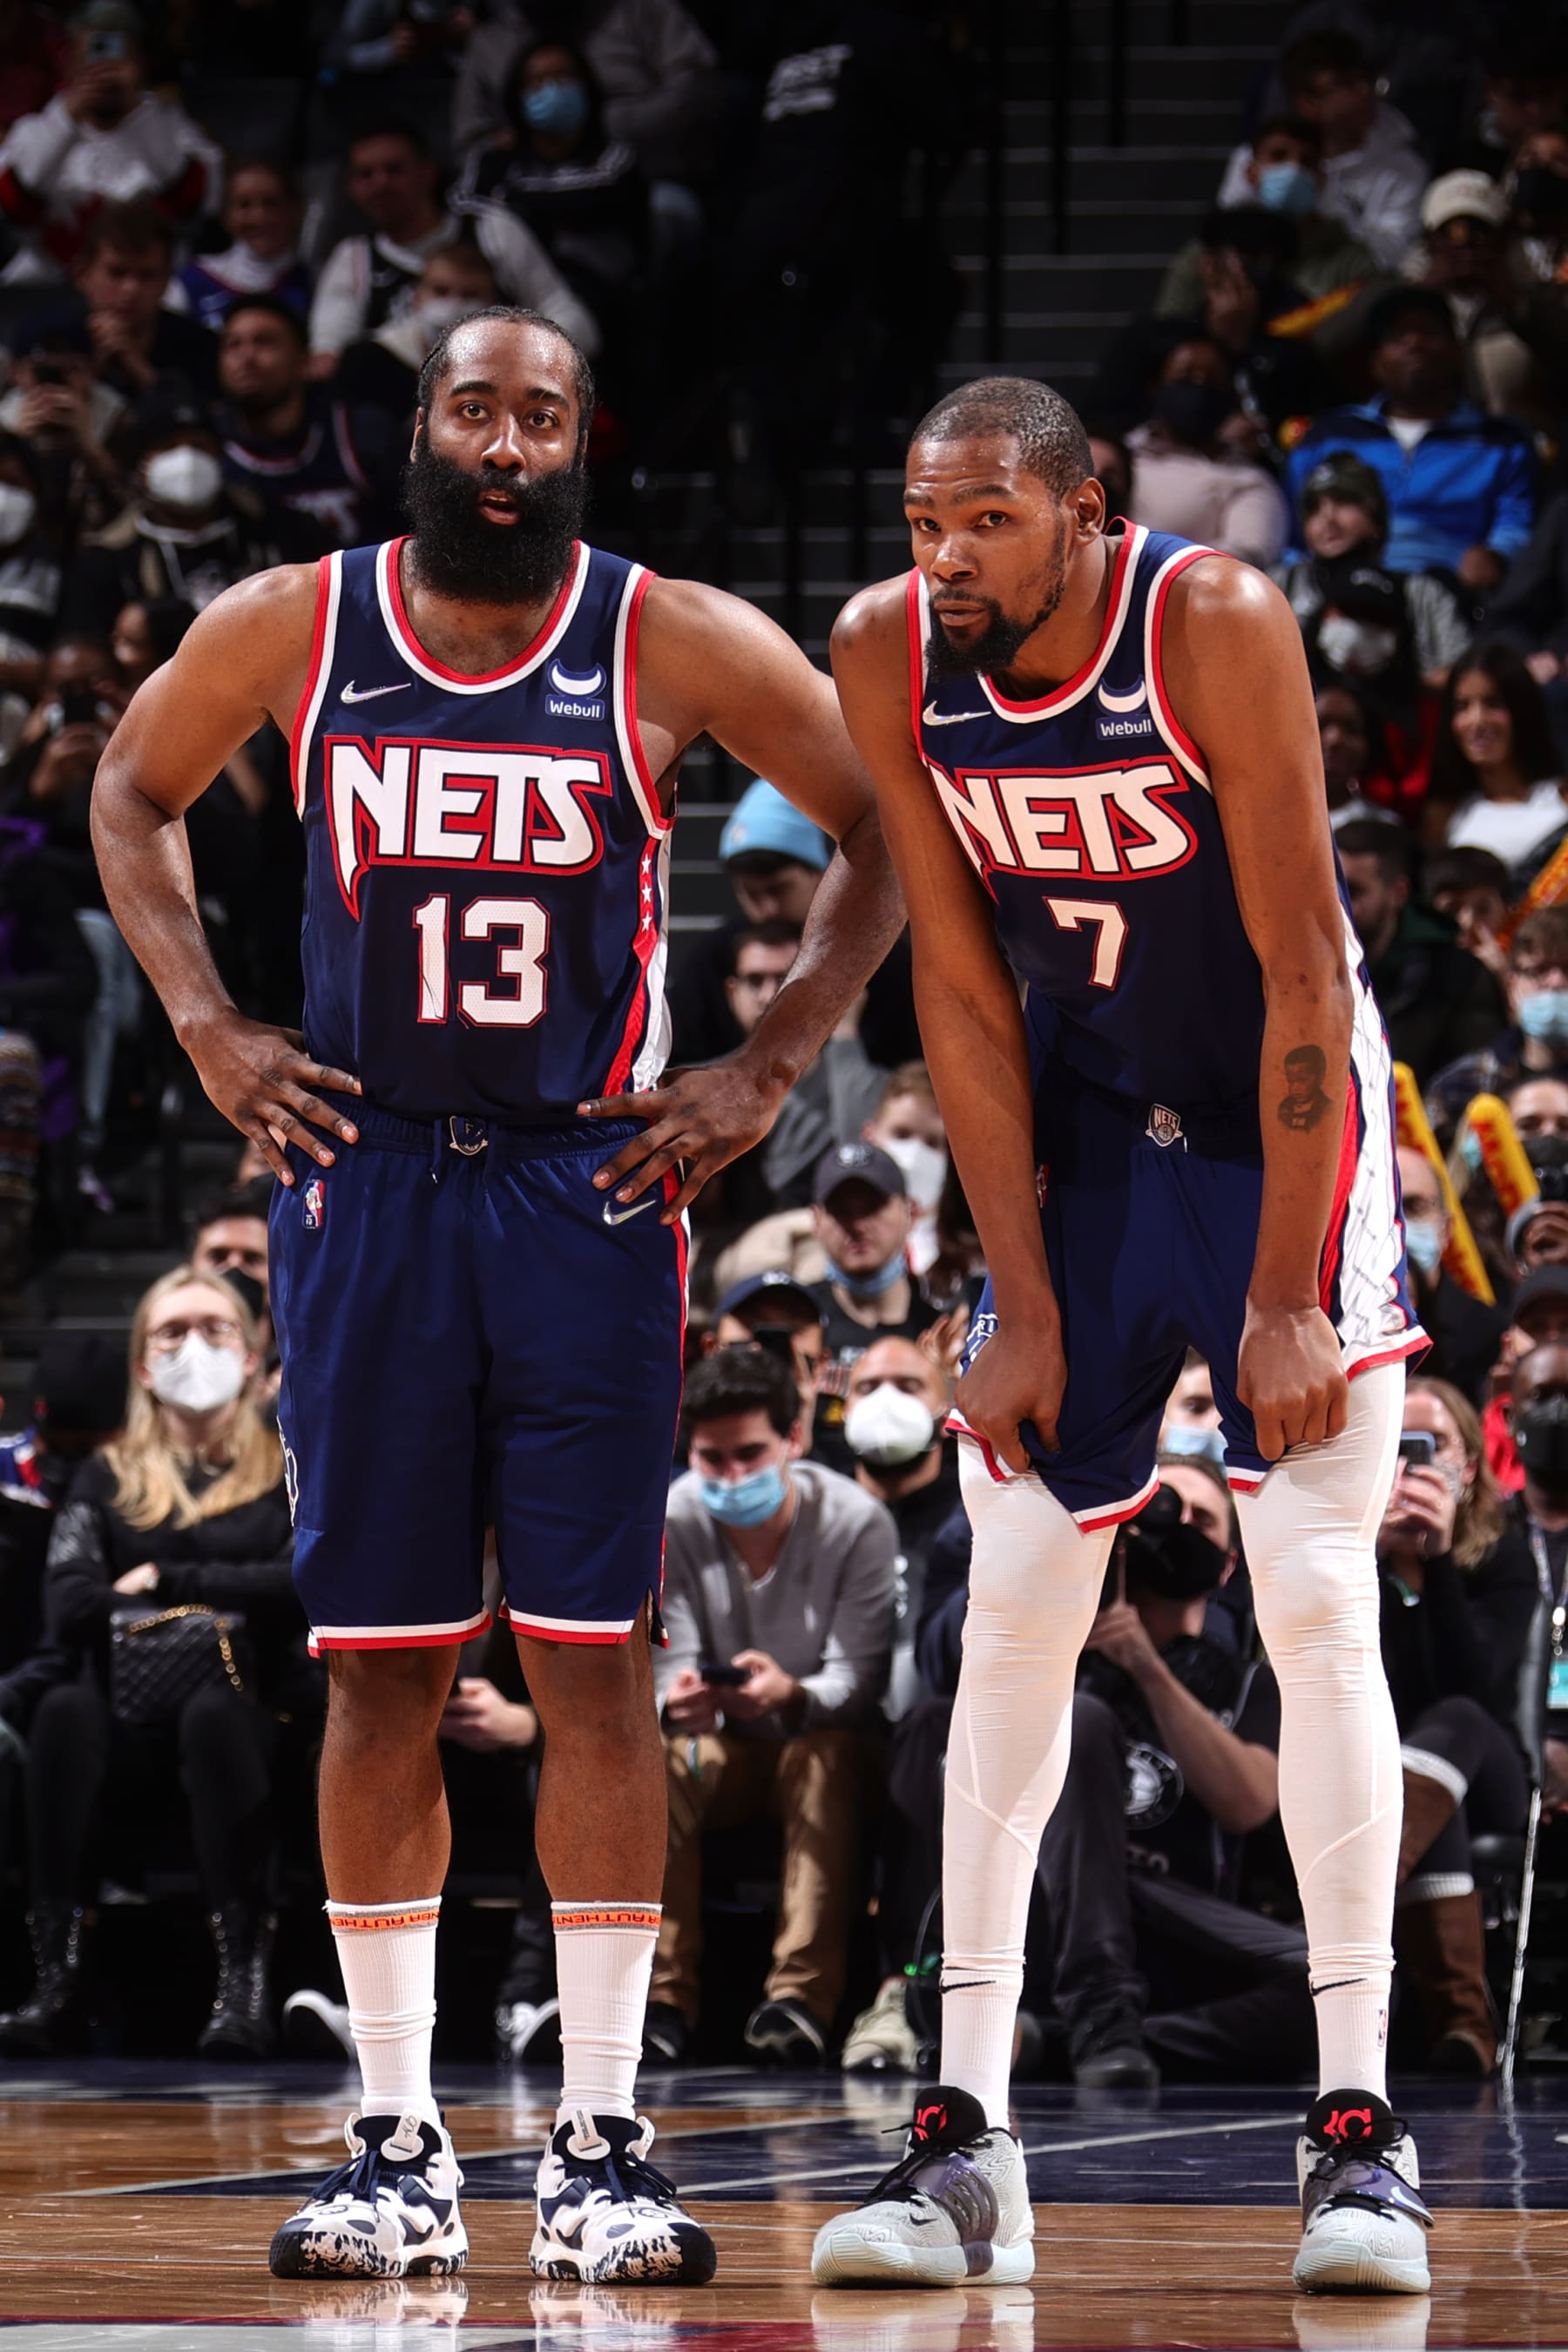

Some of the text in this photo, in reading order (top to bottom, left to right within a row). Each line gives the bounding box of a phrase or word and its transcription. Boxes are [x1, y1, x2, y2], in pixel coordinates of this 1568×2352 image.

[550, 700, 600, 719] Webull
[1100, 719, 1152, 737] Webull
[325, 736, 612, 913] NETS
[923, 757, 1196, 892] NETS
[1044, 897, 1128, 990] 7
[412, 893, 550, 1028] 13
[1152, 1106, 1179, 1131] NETS
[332, 1916, 405, 1929] AUTHE
[551, 1912, 645, 1925] AUTHENT
